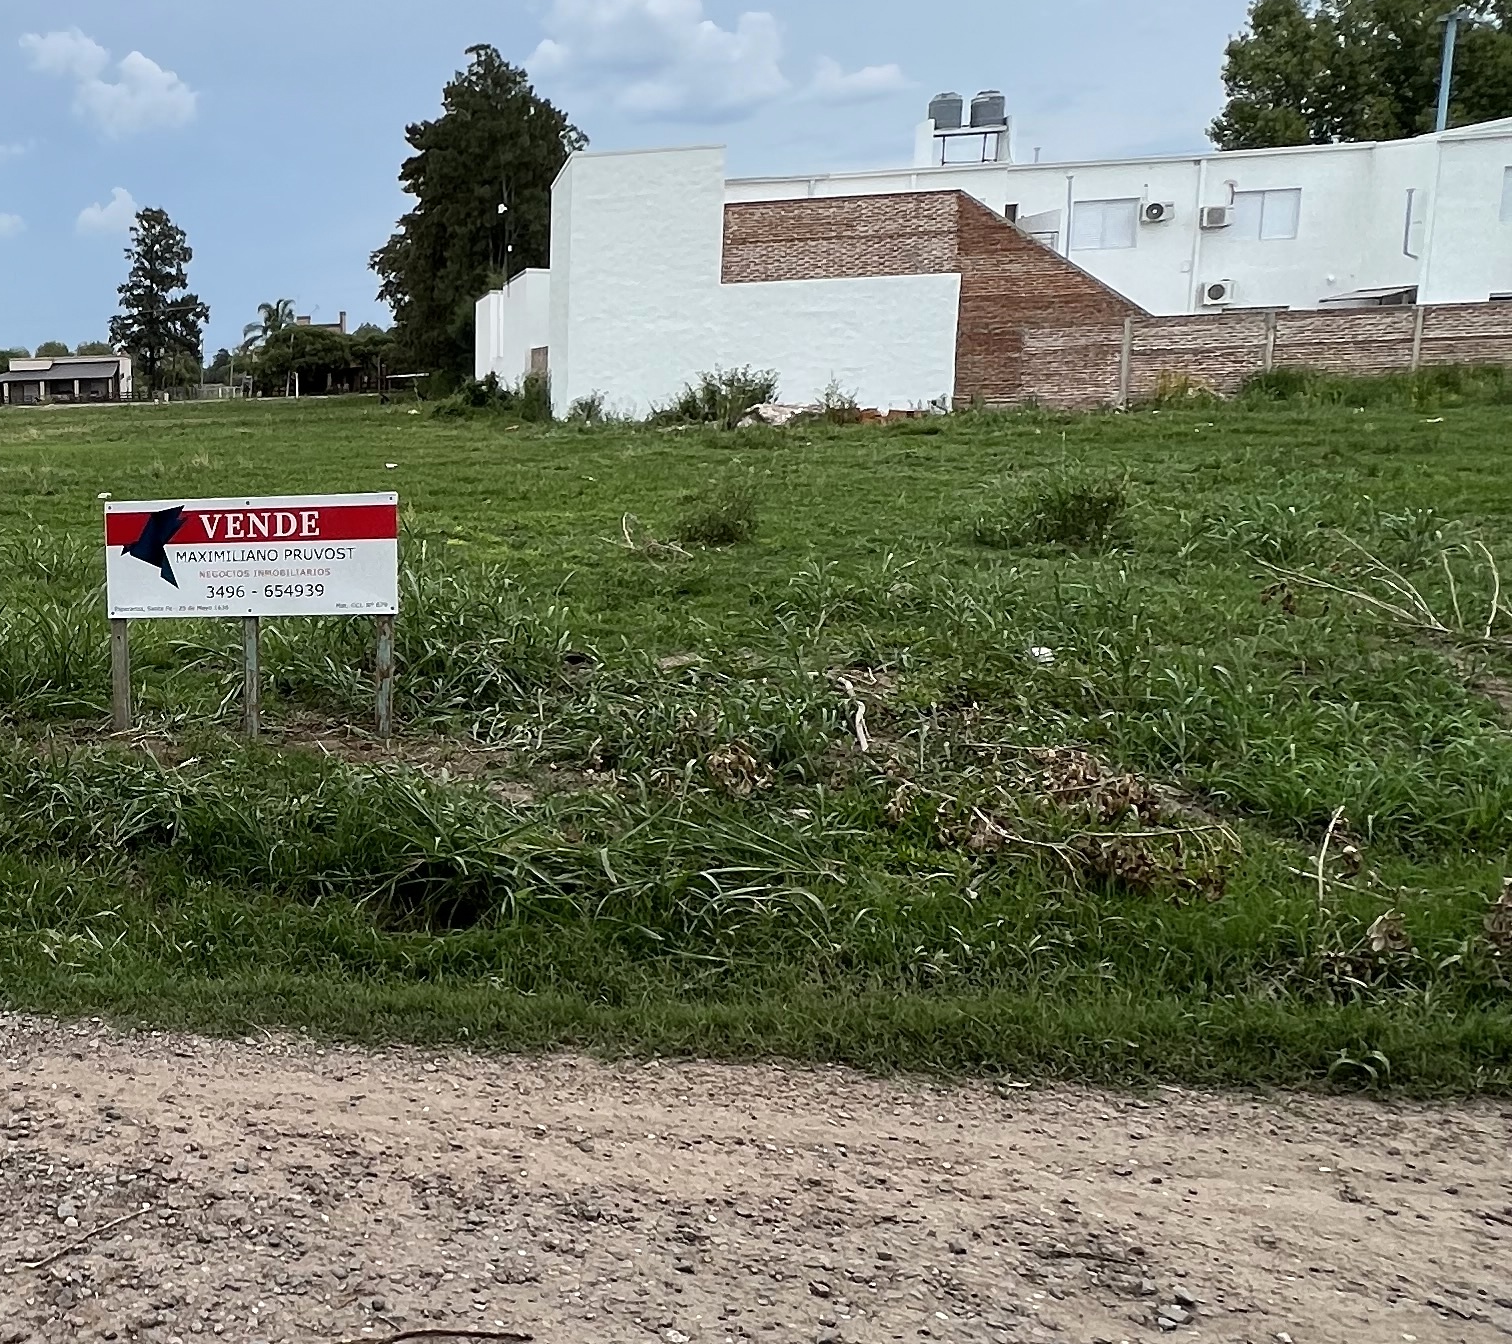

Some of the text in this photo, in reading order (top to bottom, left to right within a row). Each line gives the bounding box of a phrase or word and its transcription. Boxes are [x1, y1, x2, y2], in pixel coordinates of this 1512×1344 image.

[199, 511, 320, 539] VENDE
[176, 547, 356, 564] MAXIMILIANO PRUVOST
[199, 568, 331, 579] NEGOCIOS INMOBILIARIOS
[206, 584, 245, 599] 3496
[264, 583, 325, 598] 654939
